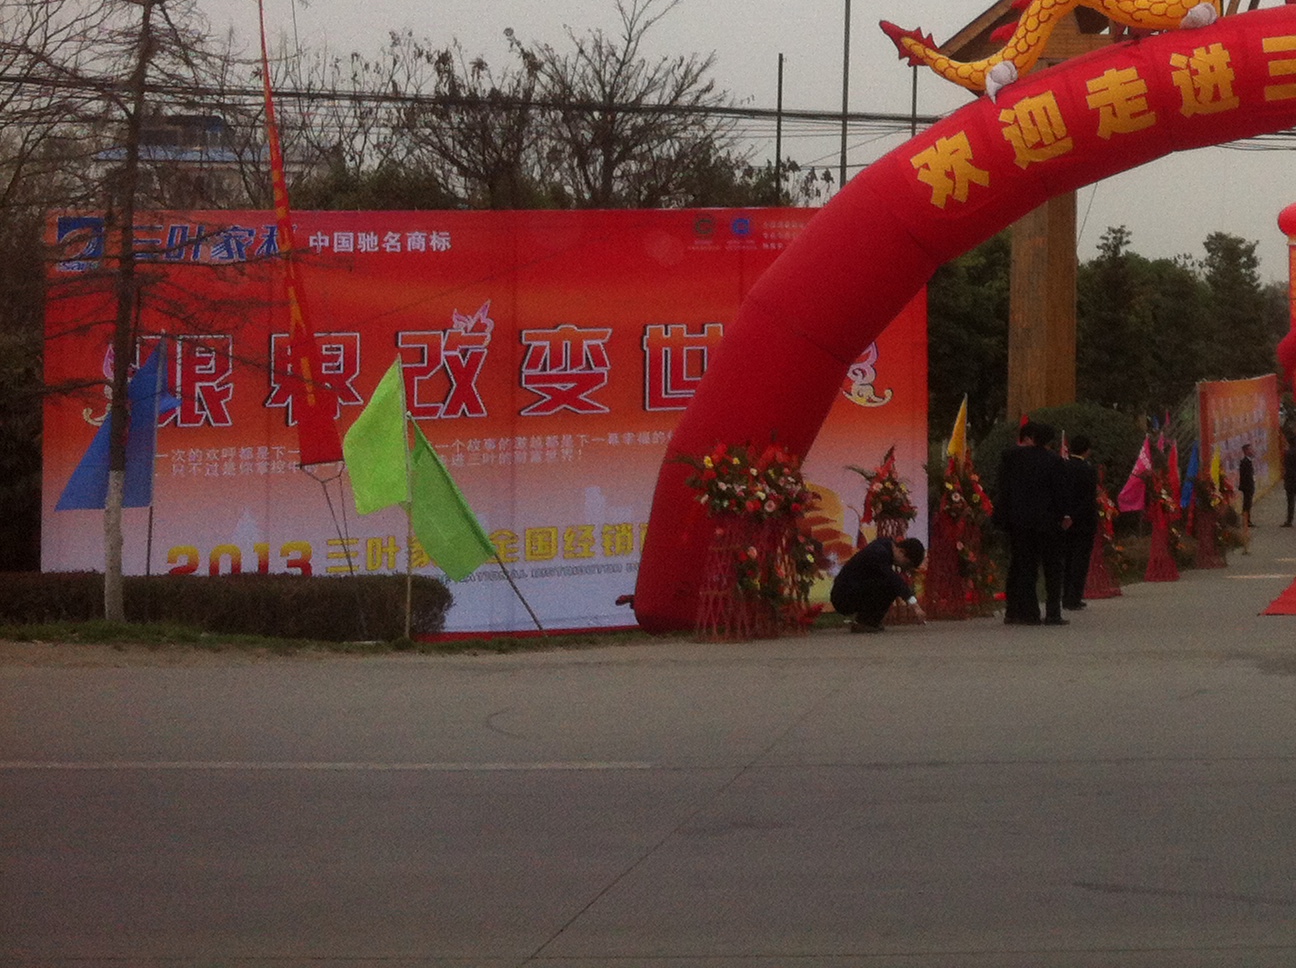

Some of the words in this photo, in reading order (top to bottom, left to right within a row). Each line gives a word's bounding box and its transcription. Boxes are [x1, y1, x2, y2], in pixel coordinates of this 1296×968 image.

[308, 230, 453, 254] 中国驰名商标
